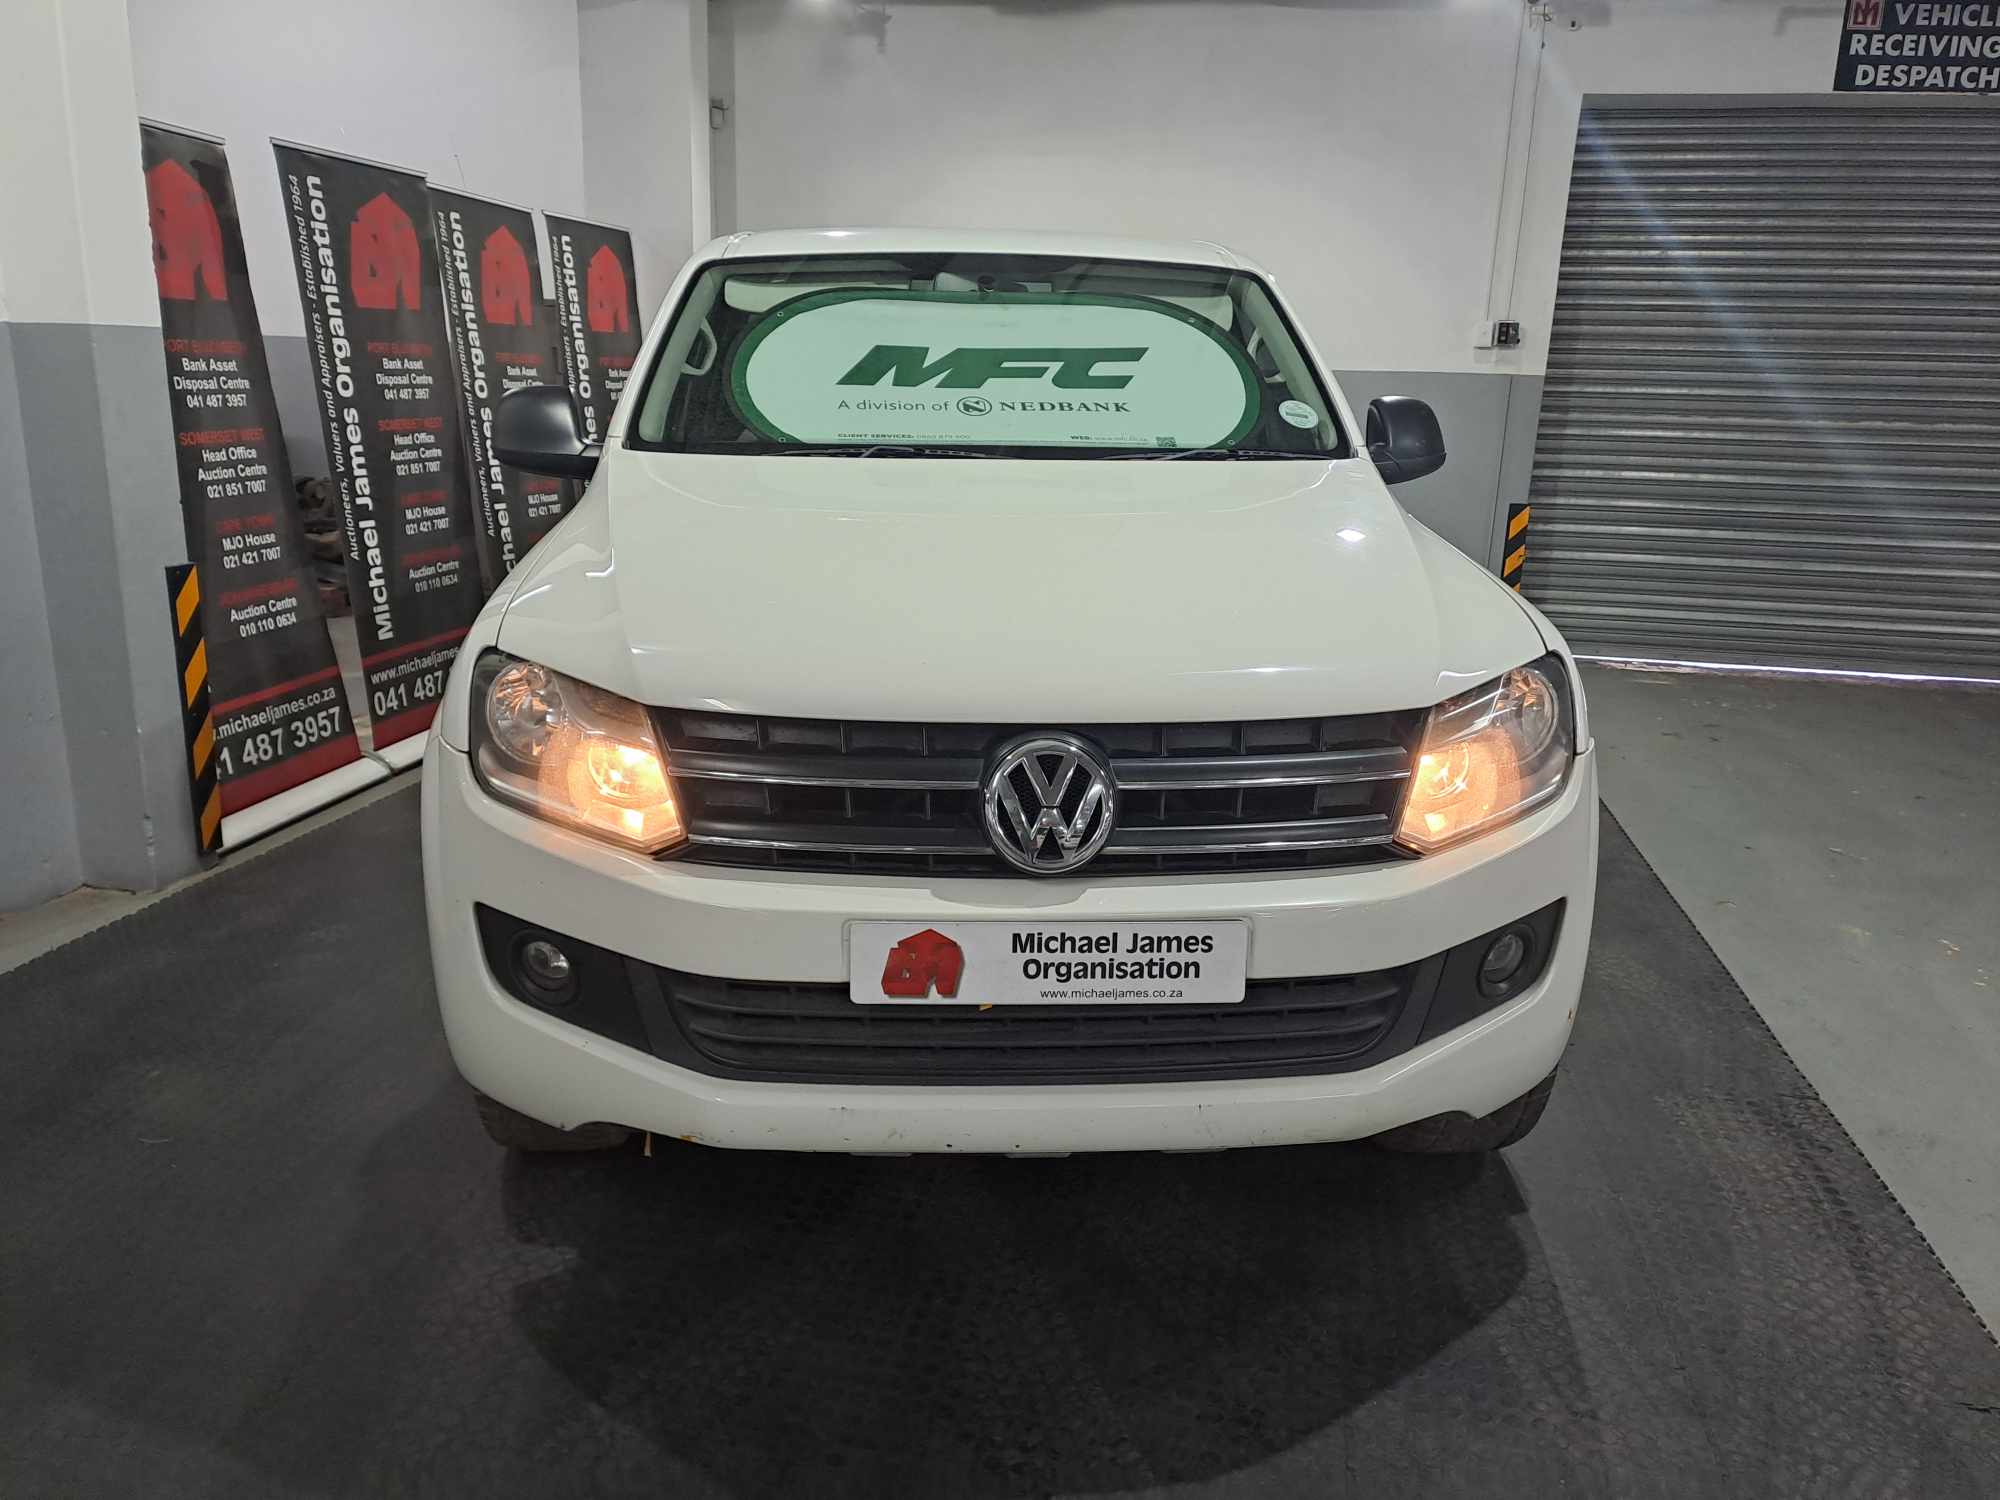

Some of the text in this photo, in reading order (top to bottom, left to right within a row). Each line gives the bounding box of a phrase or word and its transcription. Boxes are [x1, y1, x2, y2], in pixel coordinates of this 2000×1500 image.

[1849, 33, 2000, 58] RECEIVING
[1855, 65, 2000, 89] DESPATCH
[288, 174, 303, 212] 1964
[294, 215, 317, 300] Established
[450, 211, 489, 399] Organisation
[561, 235, 592, 399] Organisation
[312, 312, 332, 388] Appraisers
[182, 358, 238, 371] Bank Asset
[382, 358, 402, 369] Bank
[835, 344, 1150, 389] MFC
[173, 376, 250, 392] Disposal Centre
[375, 373, 409, 387] Disposal
[187, 394, 247, 408] 041 487 3957
[306, 175, 394, 640] Michael James Organisation
[323, 390, 336, 418] and
[465, 394, 475, 416] and
[838, 399, 850, 410] A
[856, 399, 925, 411] division
[931, 400, 950, 411] of
[1000, 401, 1131, 413] NEDBANK
[330, 421, 345, 472] Valuers
[469, 418, 482, 462] Valuers
[202, 446, 257, 462] Head Office
[390, 448, 419, 462] Auction
[198, 463, 267, 481] Auction Centre
[207, 479, 266, 498] 021 851 7007
[340, 478, 360, 560] Auctioneers,
[422, 506, 446, 517] House
[222, 532, 277, 551] MJO House
[493, 502, 516, 574] chael
[223, 546, 281, 569] 021 421 7007
[230, 597, 297, 622] Auction Centre
[239, 612, 297, 637] 010 110 0634
[374, 670, 443, 716] 041 487
[214, 687, 336, 739] .michaeljames.co.za
[242, 728, 283, 765] 487
[290, 706, 340, 748] 3957
[1011, 932, 1214, 954] Michael James
[1022, 957, 1200, 983] Organisation
[1040, 987, 1183, 1000] www.michaeljames.co.za
